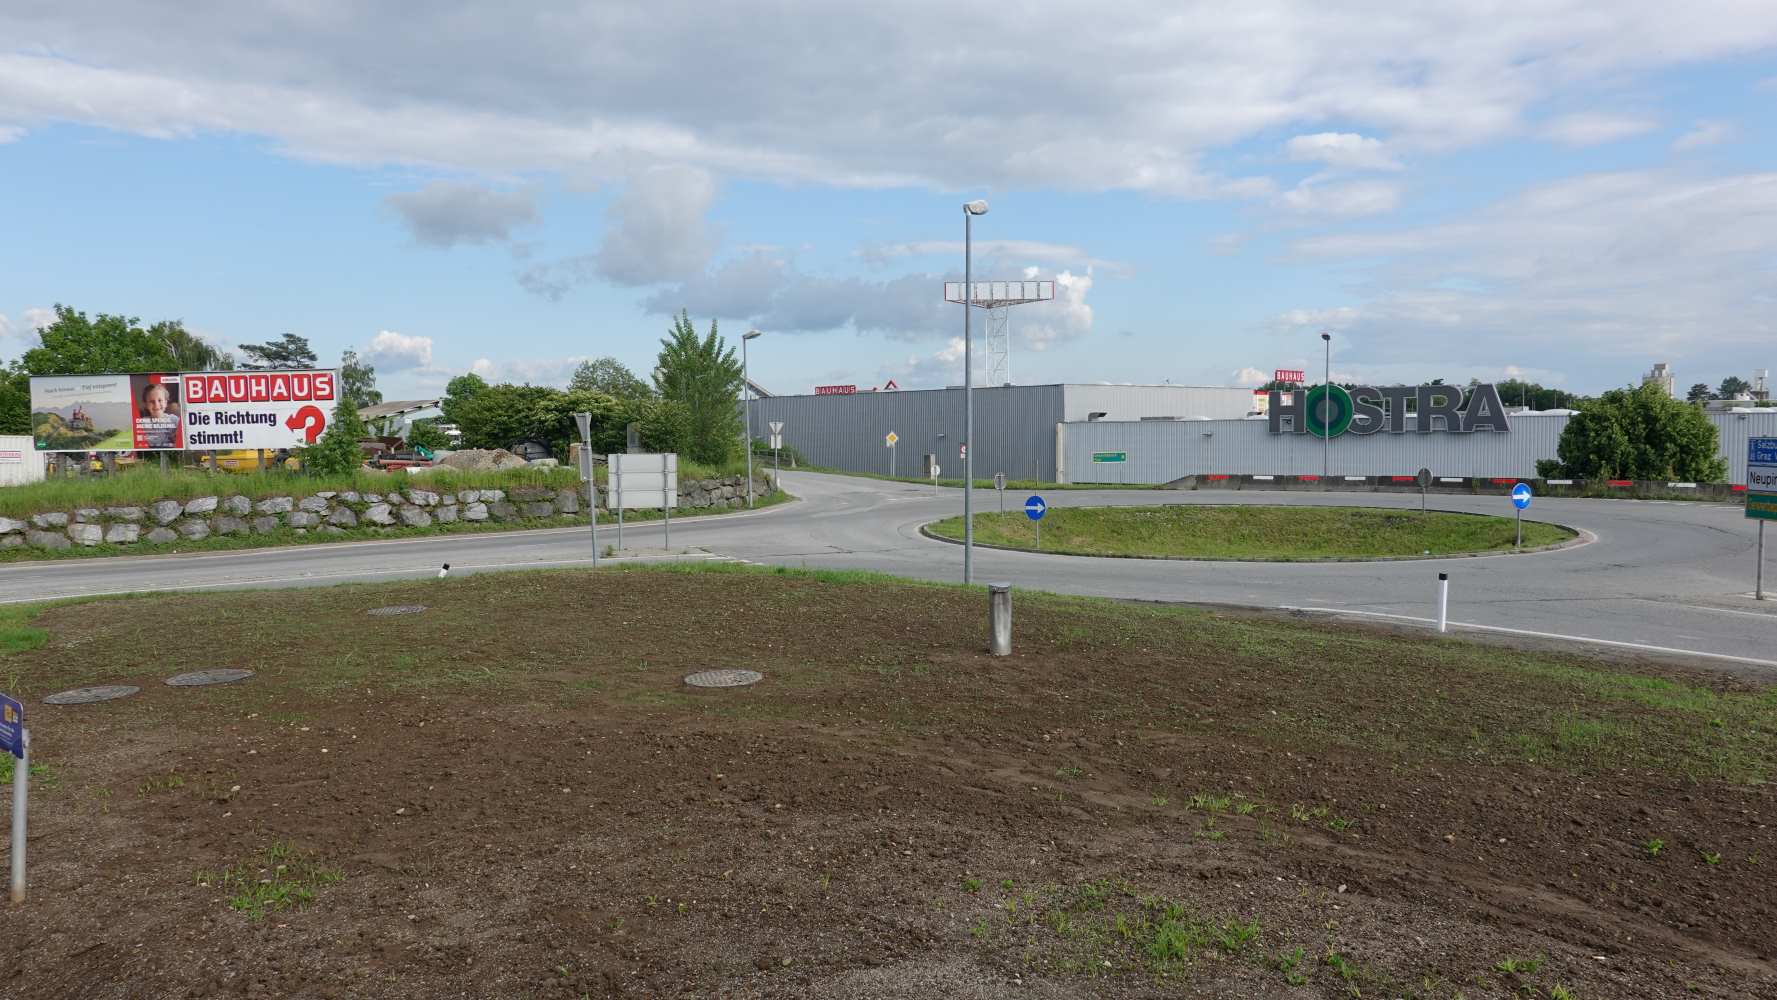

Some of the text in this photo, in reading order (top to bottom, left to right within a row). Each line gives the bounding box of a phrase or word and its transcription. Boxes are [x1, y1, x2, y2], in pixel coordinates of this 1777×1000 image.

[1275, 370, 1304, 382] BAUHAUS
[187, 375, 331, 400] BAUHAUS
[815, 386, 856, 395] BAUHAUS
[1269, 383, 1511, 438] HOSTRA
[188, 412, 210, 425] Die
[215, 411, 277, 427] Richtung
[189, 431, 243, 444] stimmt!
